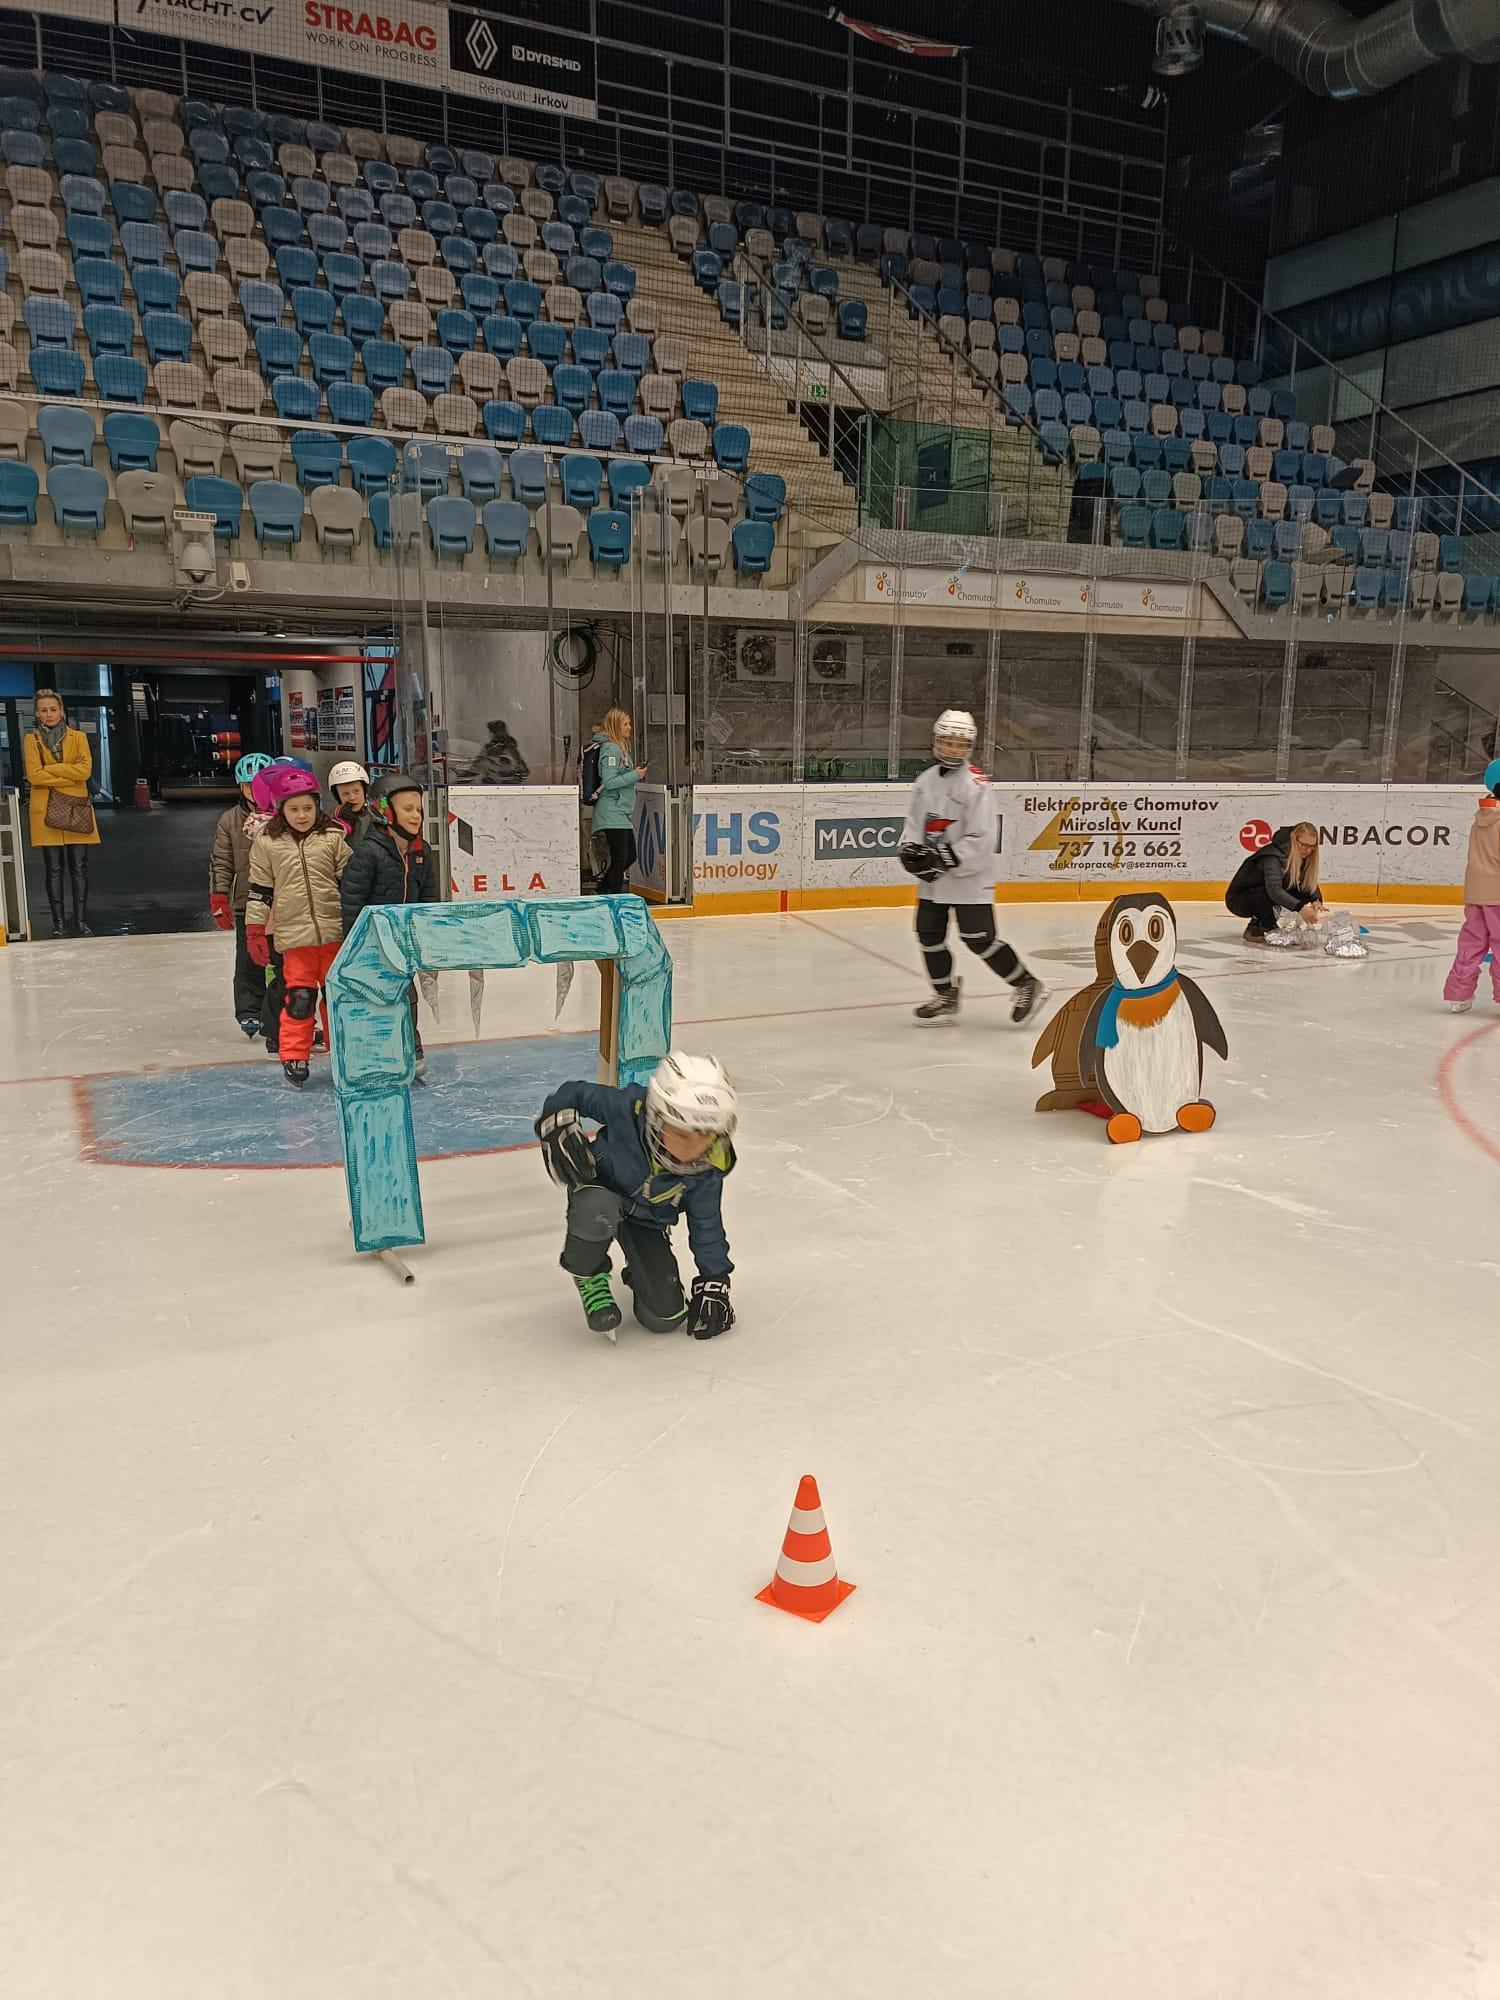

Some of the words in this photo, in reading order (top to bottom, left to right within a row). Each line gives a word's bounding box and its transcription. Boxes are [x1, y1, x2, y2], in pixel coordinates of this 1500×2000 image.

[304, 0, 437, 51] STRABAG
[305, 30, 345, 48] WORK
[350, 40, 369, 53] ON
[375, 45, 437, 68] PROGRESS
[526, 50, 581, 72] DYRSMID
[479, 80, 528, 101] Renault
[532, 92, 569, 110] Jirkov
[886, 588, 927, 598] Chomutov
[1024, 595, 1061, 606] Chomutov
[1089, 599, 1124, 609] Chomutov
[1150, 602, 1184, 613] Chomutov
[1133, 797, 1219, 811] Chomutov
[1059, 816, 1131, 832] Miroslav
[1137, 816, 1182, 831] Kuncl
[1058, 841, 1094, 857] 737
[1103, 841, 1136, 857] 162
[1143, 841, 1182, 857] 662
